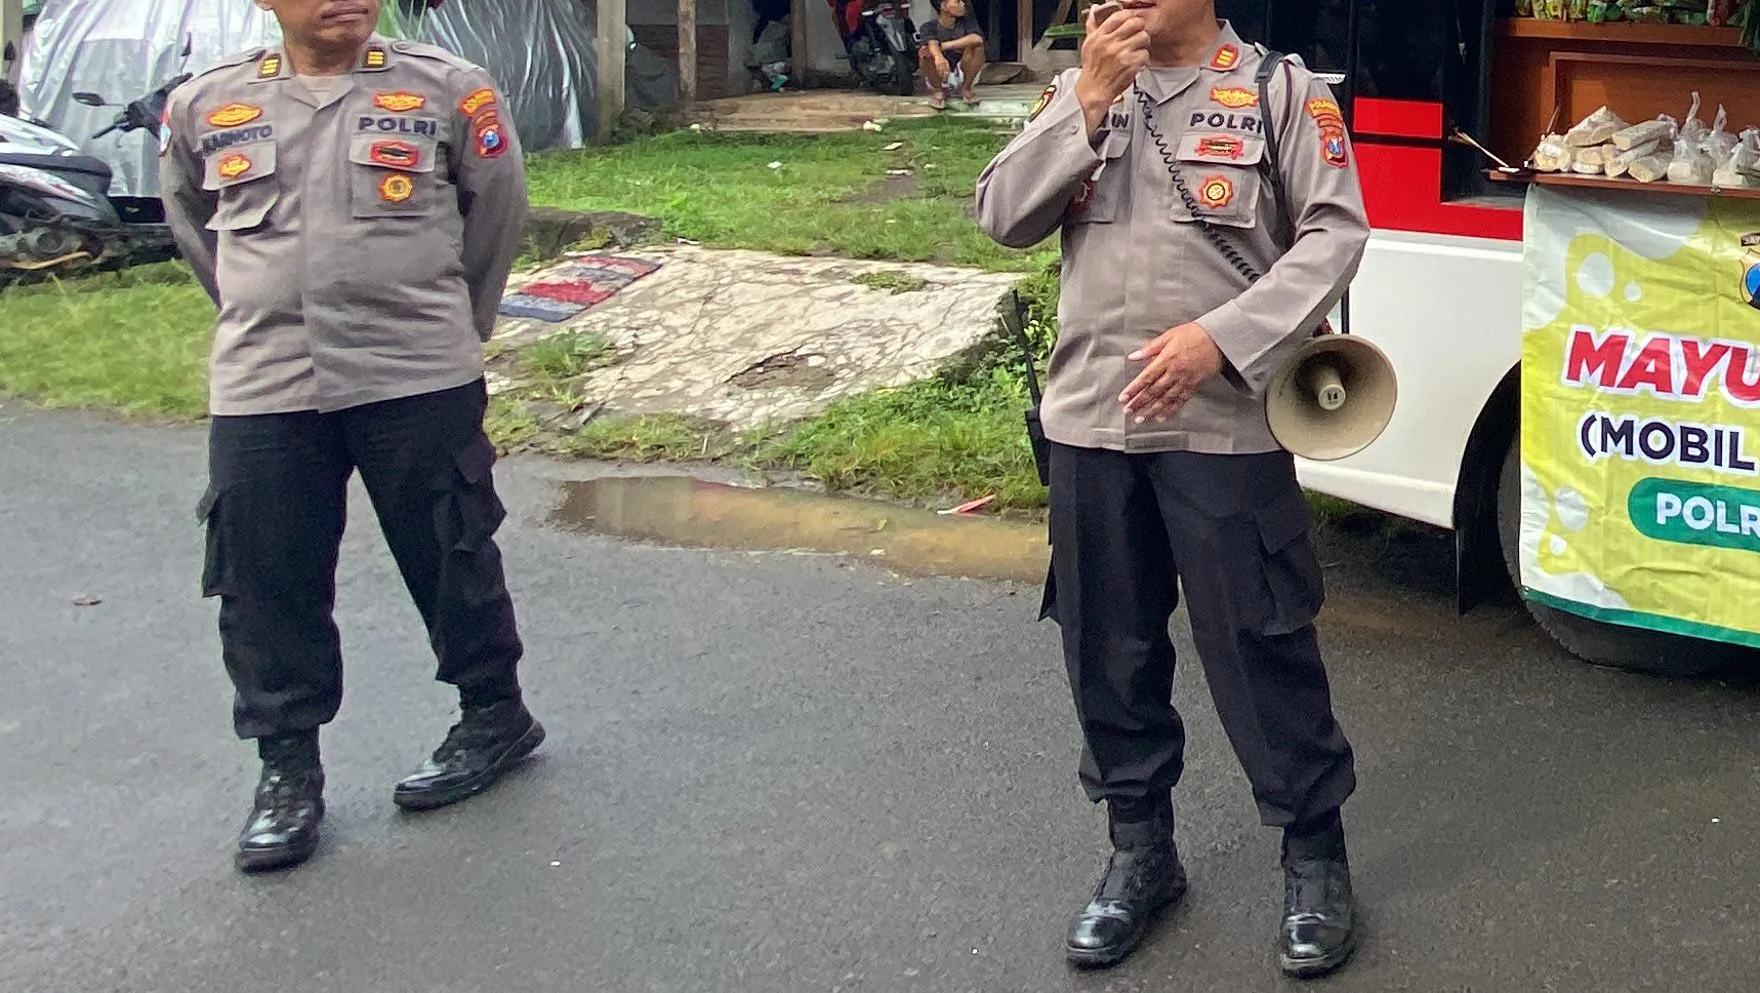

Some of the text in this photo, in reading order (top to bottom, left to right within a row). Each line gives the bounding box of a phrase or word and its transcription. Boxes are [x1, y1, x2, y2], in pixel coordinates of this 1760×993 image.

[359, 117, 437, 136] POLRI
[1190, 113, 1263, 134] POLRI
[1581, 414, 1756, 472] (MOBIL
